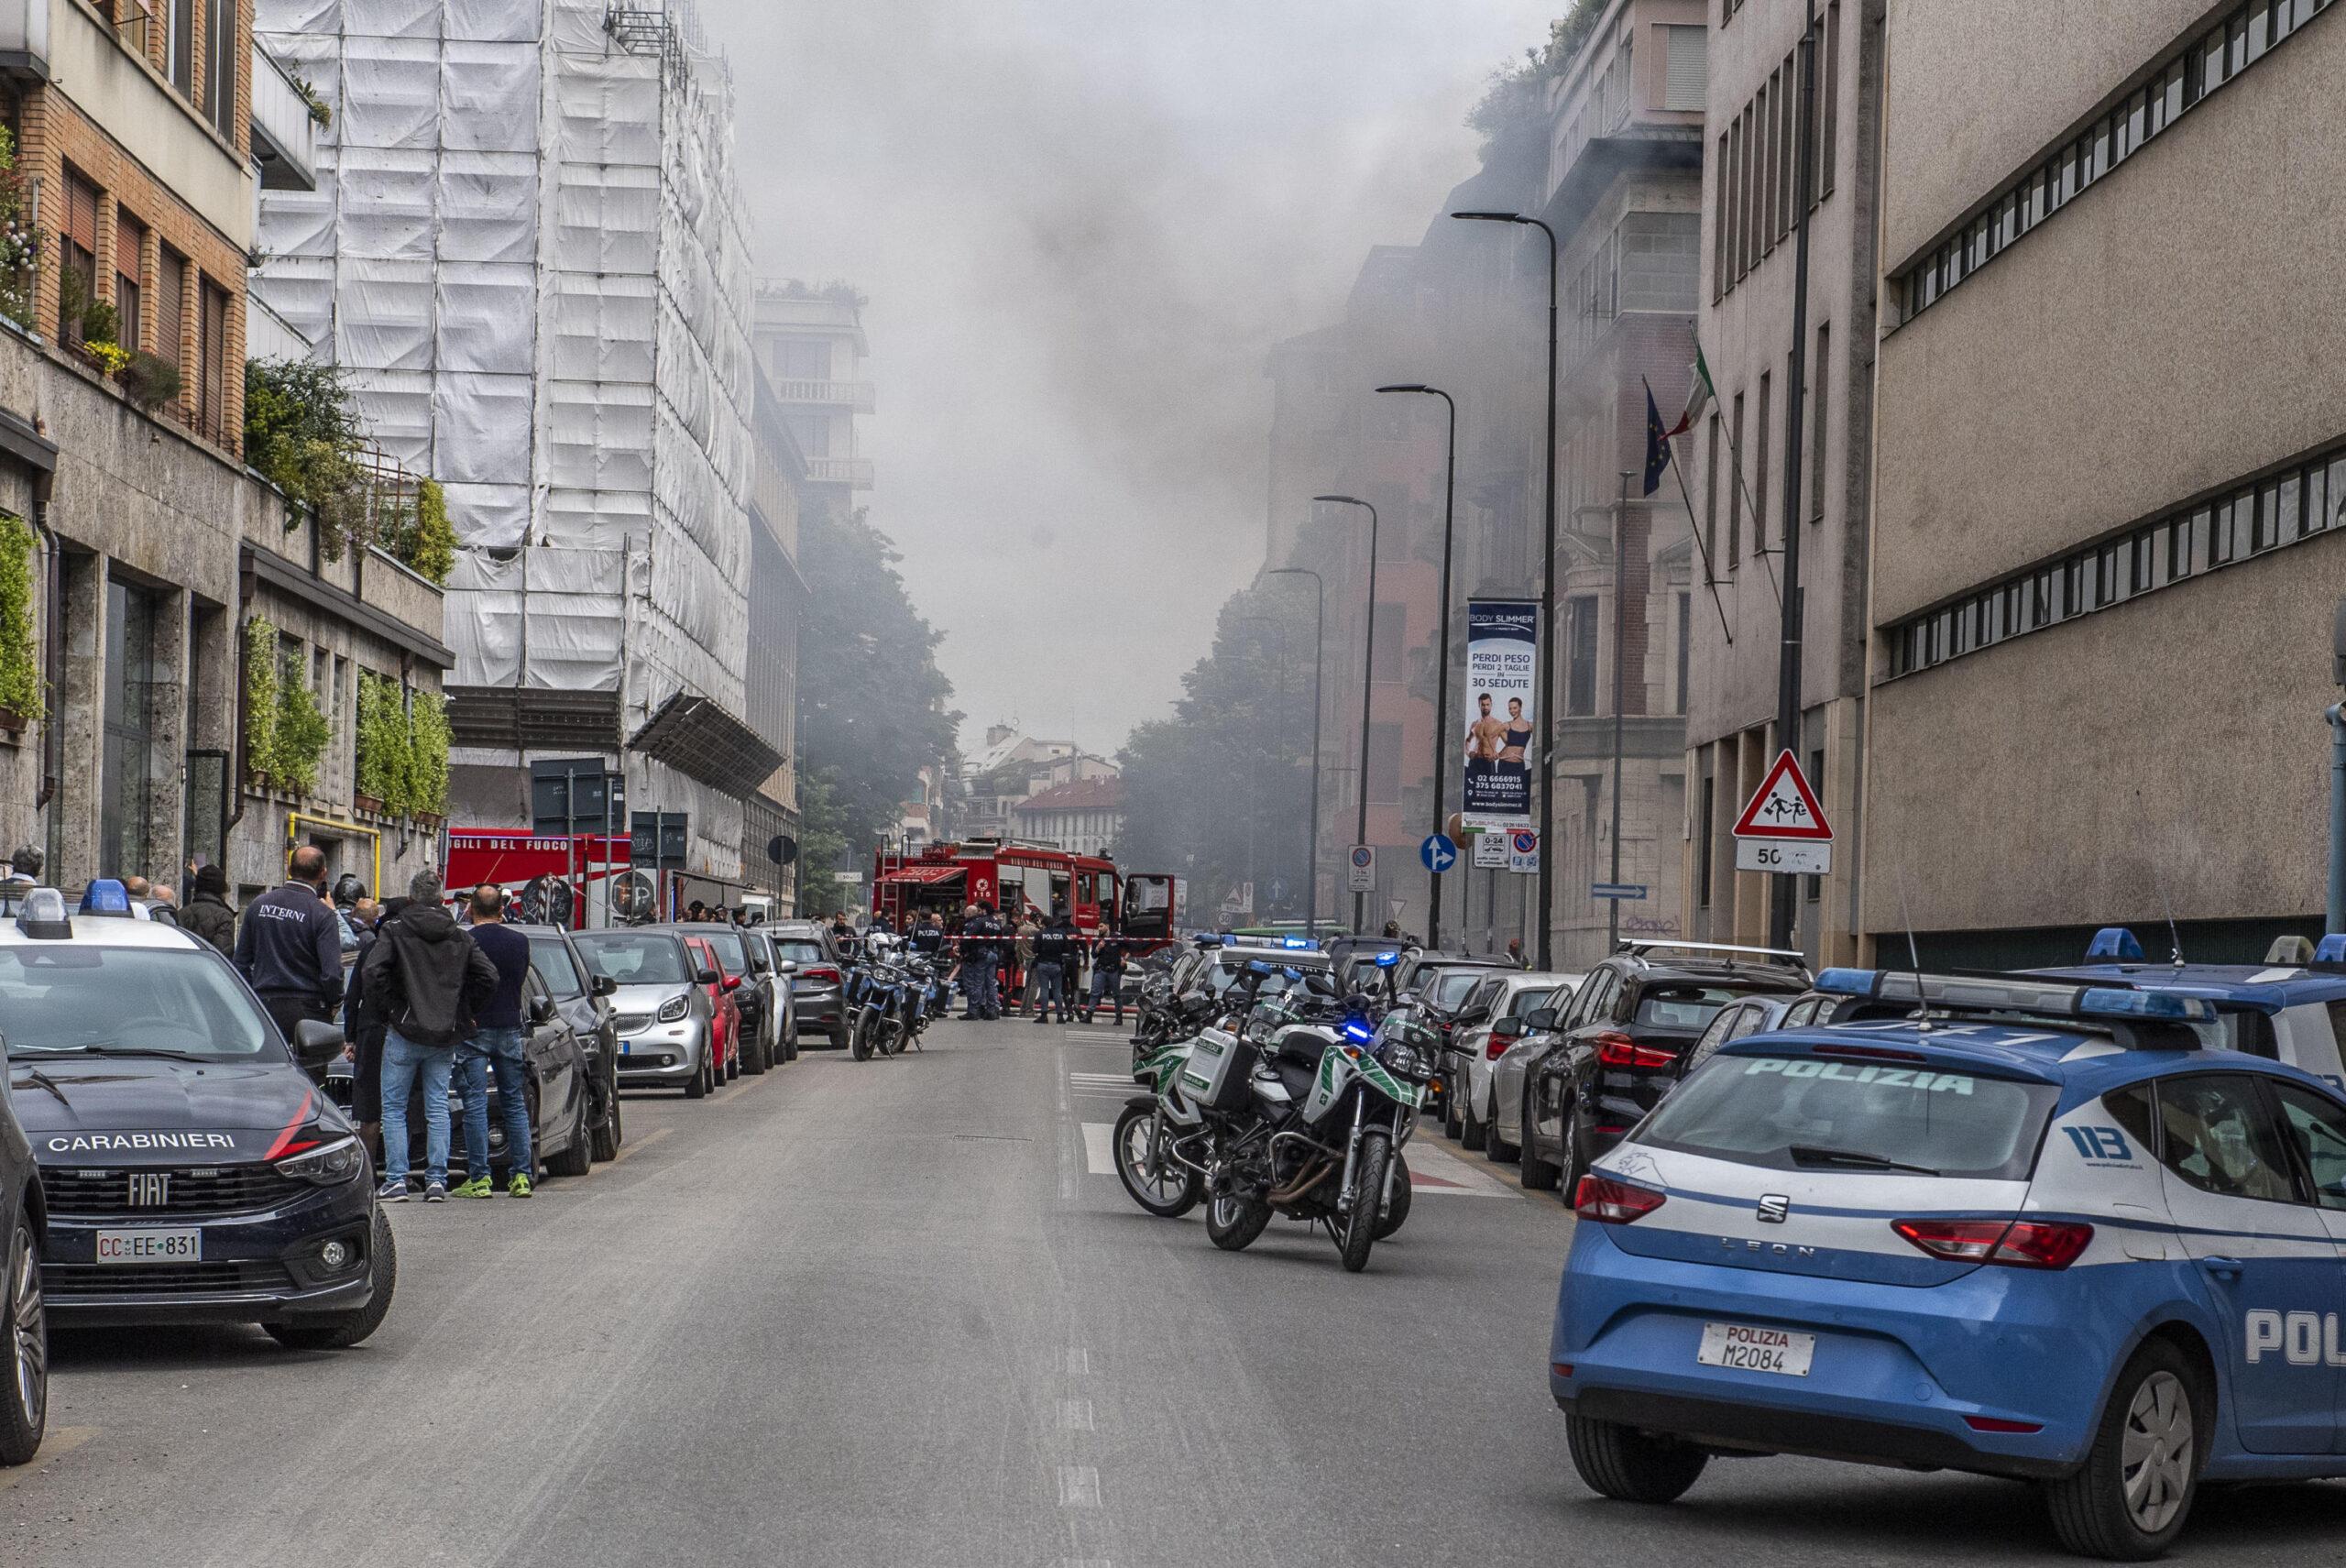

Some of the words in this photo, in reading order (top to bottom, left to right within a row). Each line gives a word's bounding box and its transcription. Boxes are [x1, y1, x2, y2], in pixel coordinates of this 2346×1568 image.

[1469, 614, 1493, 622] BODY
[1496, 614, 1534, 623] SLIMMER
[1472, 653, 1501, 663] PERDI
[1504, 654, 1530, 663] PESO
[1472, 663, 1495, 671] PERDI
[1472, 678, 1485, 687] 30
[1488, 679, 1529, 688] SEDUTE
[490, 840, 516, 850] DEL
[526, 840, 567, 850] FUOCO
[259, 905, 306, 923] INTERNI
[1745, 1058, 1974, 1096] POLIZIA
[49, 1133, 236, 1152] CARABINIERI
[2062, 1126, 2133, 1160] 113
[127, 1173, 171, 1206] FIAT
[99, 1237, 122, 1256] CC
[134, 1237, 156, 1255] EE
[166, 1235, 196, 1255] 831
[1721, 1237, 1815, 1258] LEON
[1727, 1326, 1789, 1348] POLIZIA
[1721, 1343, 1784, 1372] M2084
